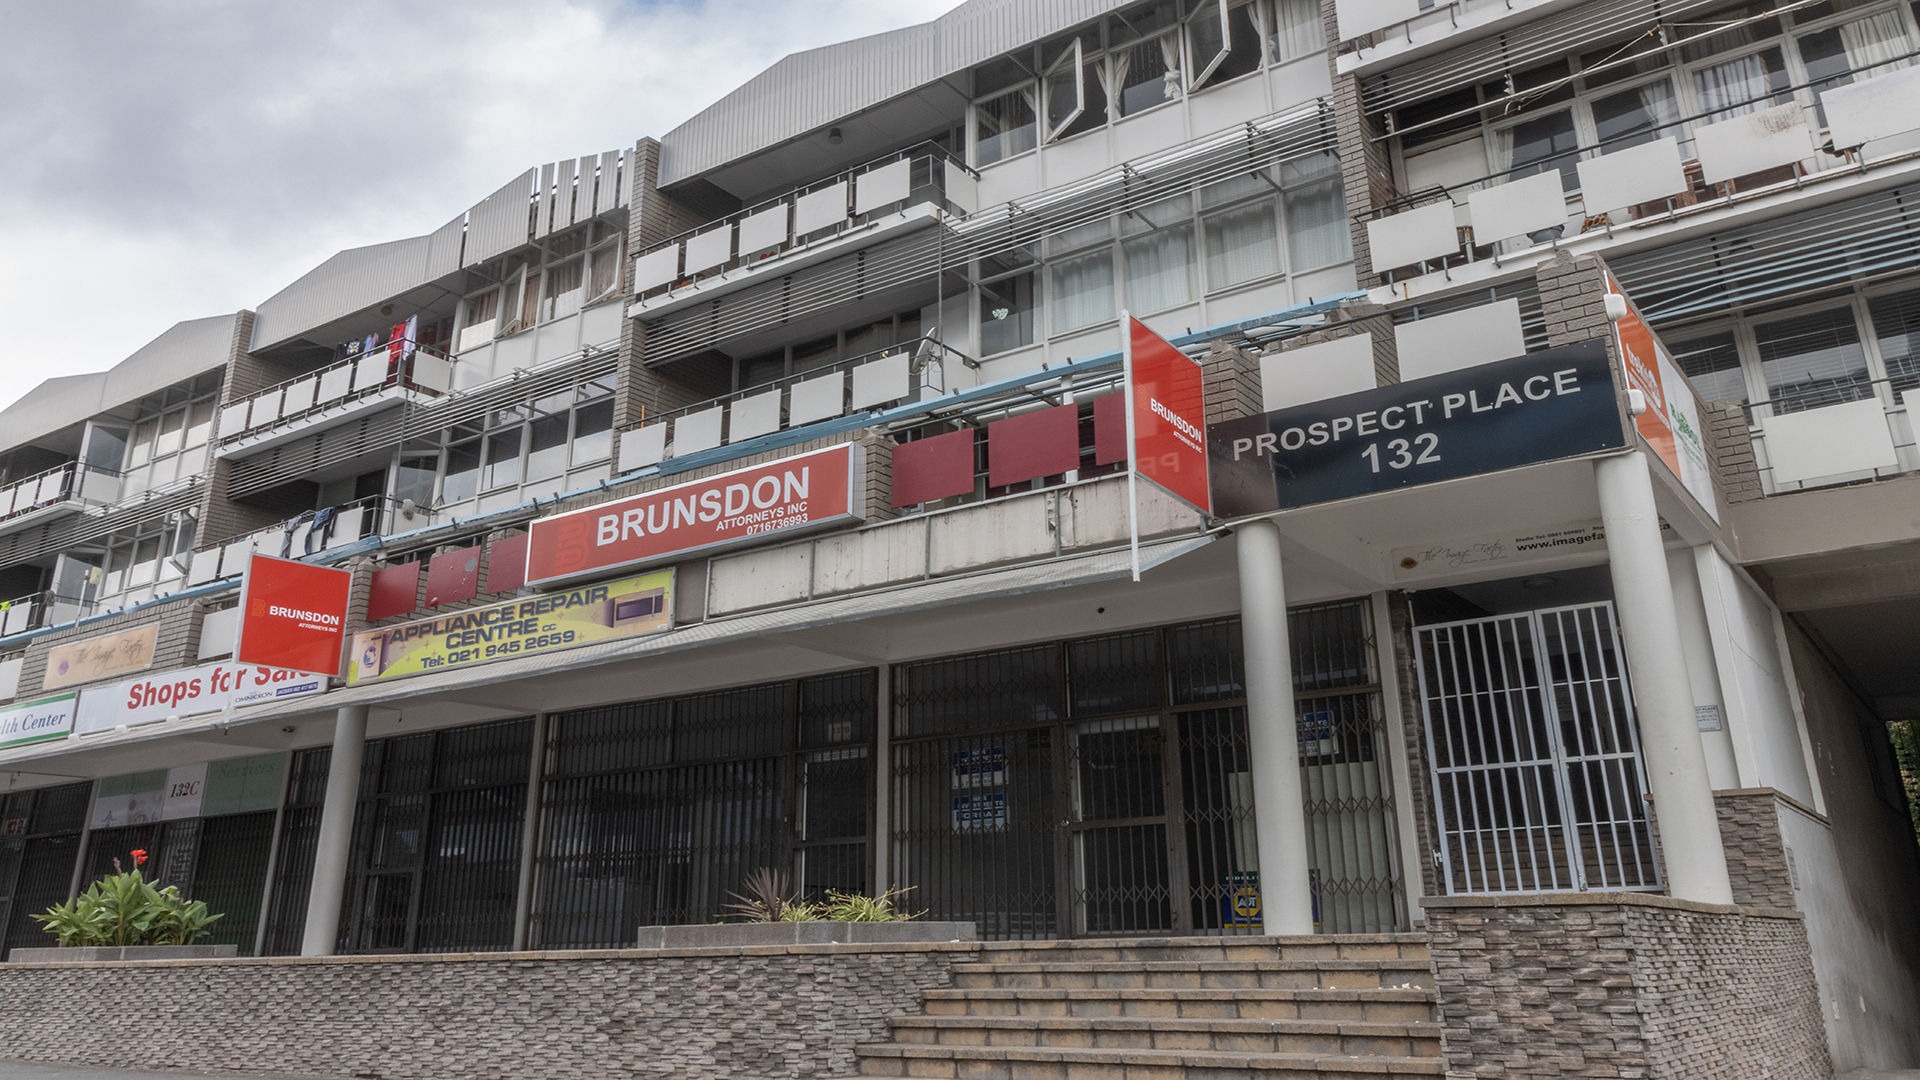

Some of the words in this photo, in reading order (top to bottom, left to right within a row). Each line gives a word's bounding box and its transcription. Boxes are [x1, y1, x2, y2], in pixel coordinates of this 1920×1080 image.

[1150, 398, 1202, 443] BRUNSDON
[1233, 400, 1430, 461] PROSPECT
[1443, 368, 1581, 419] PLACE
[1361, 432, 1441, 473] 132
[597, 467, 809, 546] BRUNSDON
[716, 507, 784, 531] ATTORNEYS
[787, 501, 808, 515] INC
[747, 513, 808, 536] 0716736993
[1516, 532, 1605, 551] www.imagefa
[269, 605, 339, 625] BRUNSDON
[298, 622, 328, 632] ATTORNEYS
[390, 605, 515, 644] APPLIANCE
[519, 586, 608, 619] REPAIR
[446, 617, 539, 649] CENTRE
[421, 655, 444, 669] Tel:
[448, 649, 480, 664] 021
[485, 640, 520, 658] 945
[524, 630, 575, 650] 2659
[127, 677, 201, 710] Shops
[210, 667, 248, 695] for
[22, 713, 66, 731] Center
[170, 780, 200, 798] 132C
